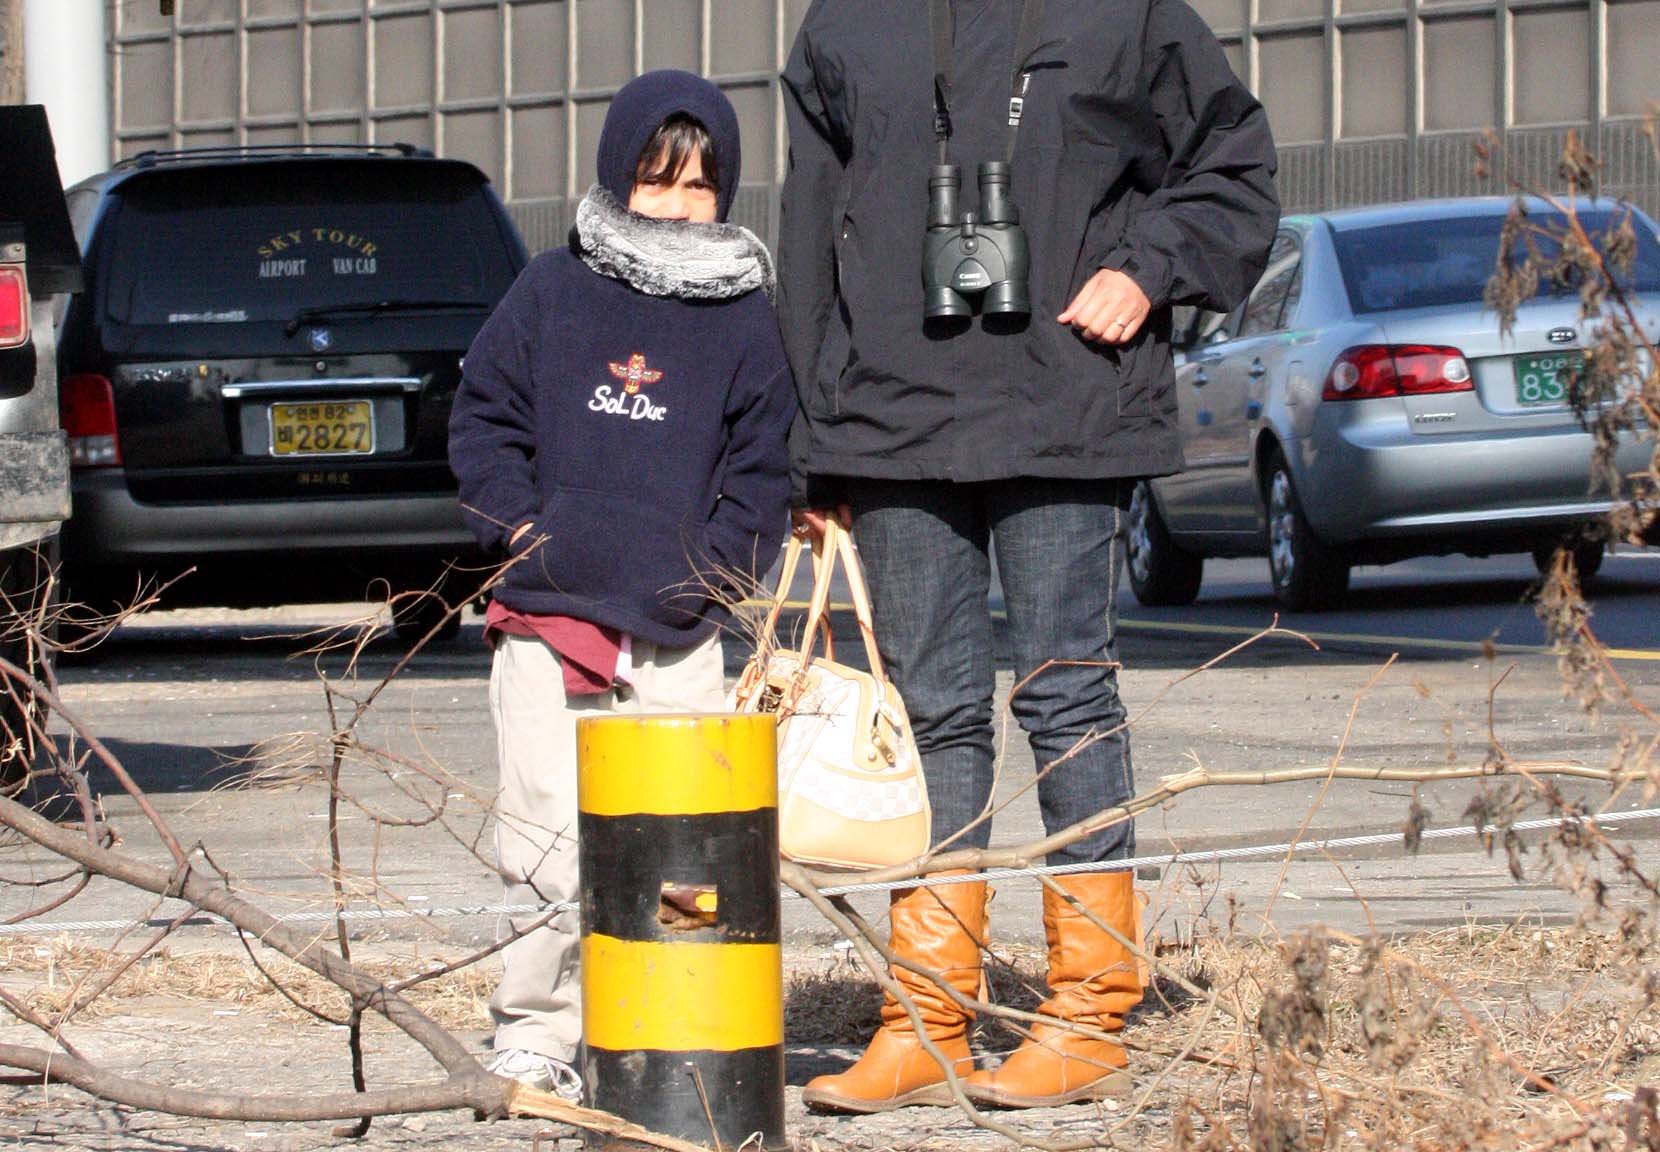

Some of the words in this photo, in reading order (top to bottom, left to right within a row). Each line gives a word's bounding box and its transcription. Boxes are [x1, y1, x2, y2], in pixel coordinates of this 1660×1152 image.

[257, 230, 301, 258] SKY
[312, 227, 377, 257] TOUR
[258, 259, 306, 278] AIRPORT
[333, 257, 353, 275] VAN
[355, 257, 378, 275] CAB
[296, 421, 367, 450] 2827
